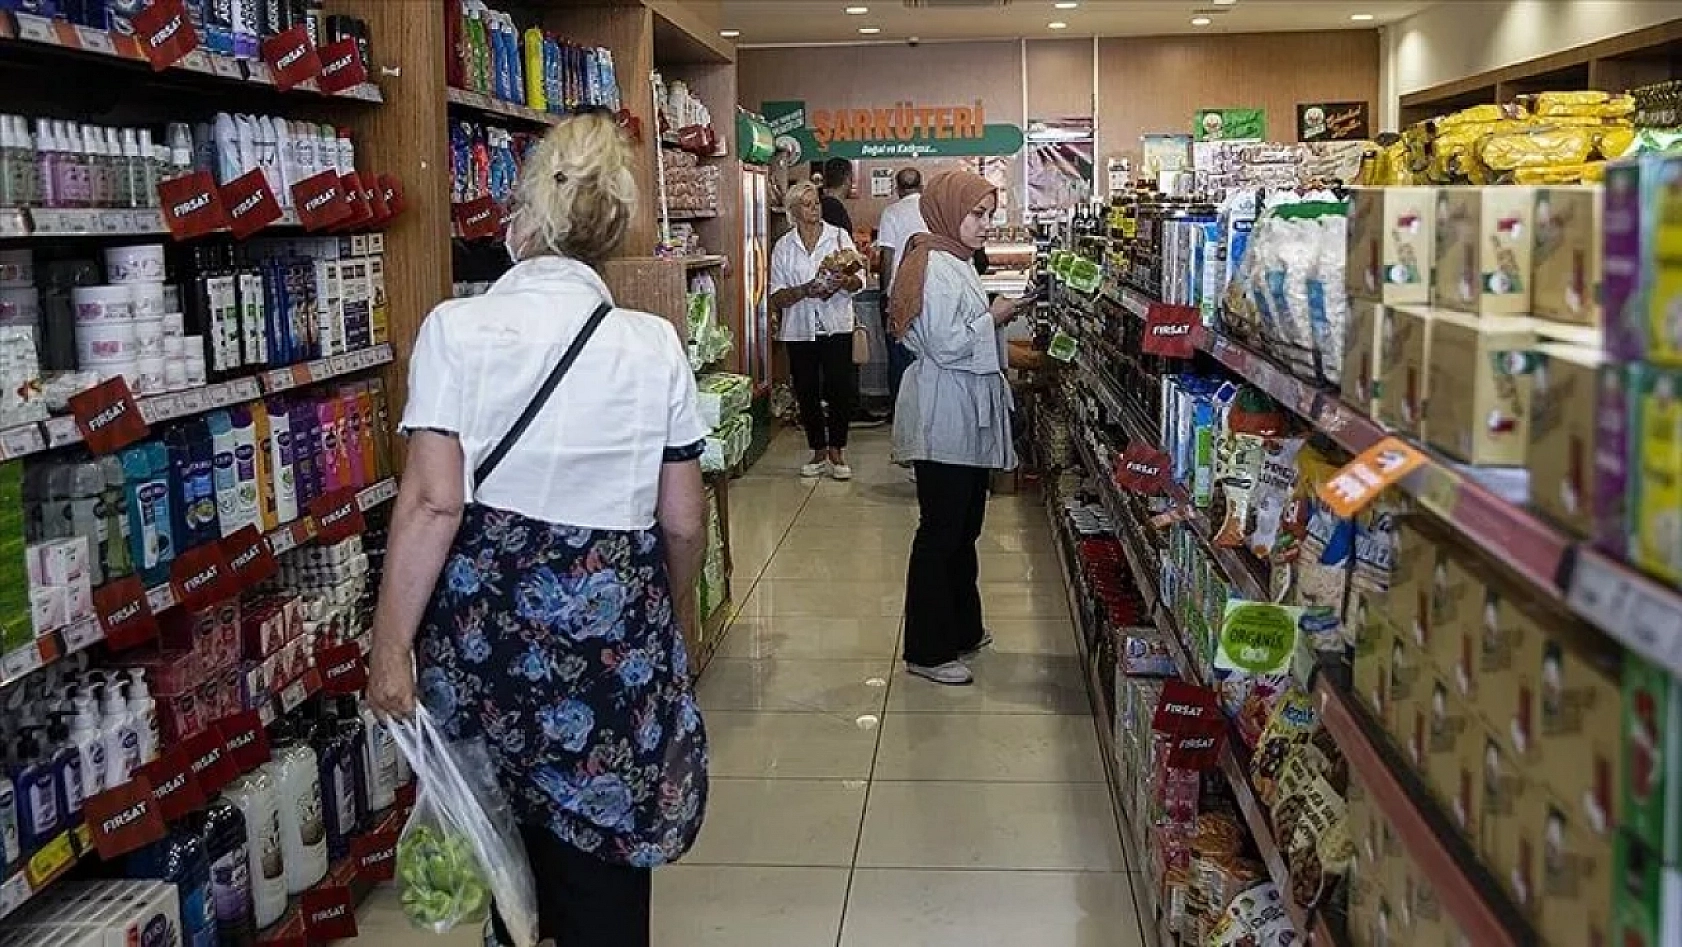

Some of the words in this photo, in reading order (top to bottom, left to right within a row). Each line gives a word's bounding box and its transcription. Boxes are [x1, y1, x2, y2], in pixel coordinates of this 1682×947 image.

[150, 15, 182, 49] FIRSAT
[277, 45, 307, 71] FIRSAT
[321, 53, 353, 77] FIRSAT
[812, 99, 985, 153] ŞARKÜTERİ
[172, 192, 210, 218] FIRSAT
[231, 188, 265, 218] FIRSAT
[304, 188, 336, 212] FIRSAT
[1152, 324, 1190, 336] FIRSAT
[89, 400, 127, 431] FIRSAT
[1126, 462, 1160, 476] FIRSAT
[321, 503, 352, 527] FIRSAT
[230, 543, 261, 571] FIRSAT
[183, 564, 218, 593] FIRSAT
[107, 600, 141, 626] FIRSAT
[325, 658, 357, 679] FIRSAT
[1163, 702, 1204, 717] FIRSAT
[102, 801, 148, 835] FIRSAT
[361, 848, 394, 867] FIRSAT
[310, 904, 346, 924] FIRSAT
